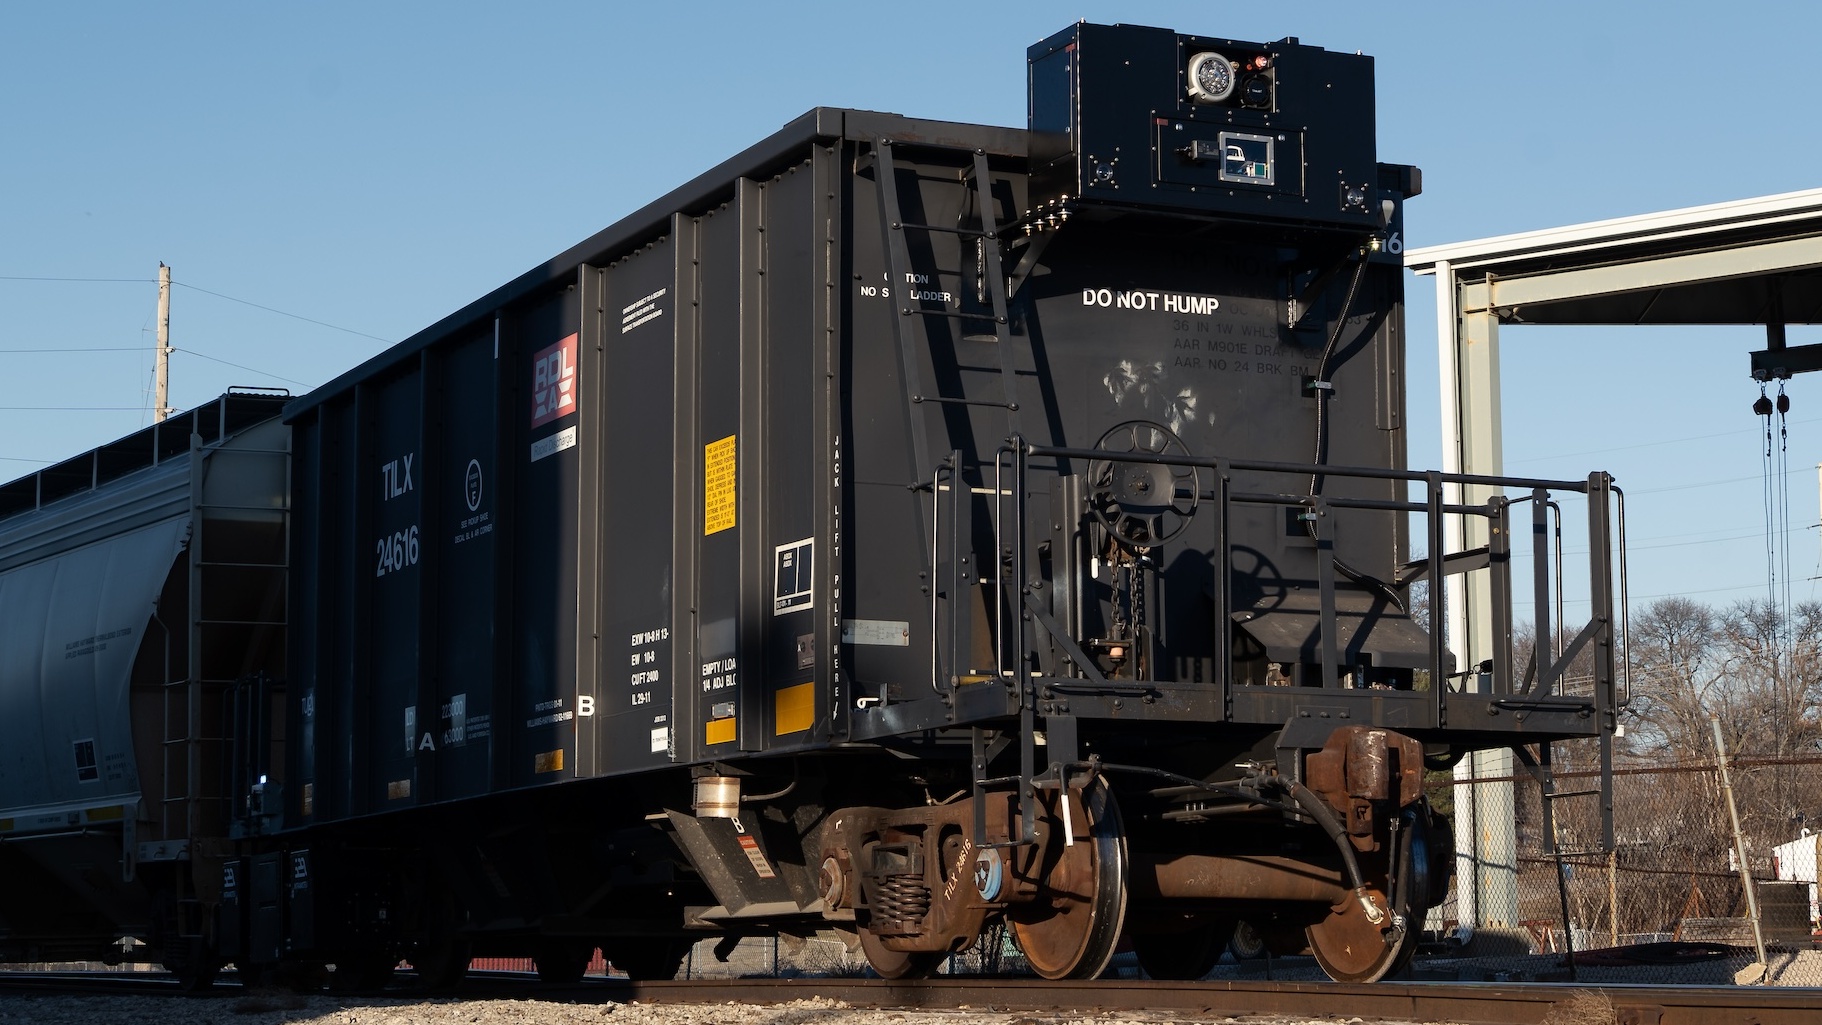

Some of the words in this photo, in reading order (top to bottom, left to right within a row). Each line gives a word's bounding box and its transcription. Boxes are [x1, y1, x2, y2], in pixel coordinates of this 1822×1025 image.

[860, 286, 876, 296] NO
[910, 290, 951, 302] LADDER
[1083, 288, 1112, 307] DO
[1116, 290, 1159, 310] NOT
[1164, 294, 1219, 315] HUMP
[1174, 320, 1188, 332] 36
[1197, 321, 1209, 332] IN
[1174, 338, 1200, 350] AAR
[1174, 356, 1200, 368] AAR
[1208, 358, 1227, 371] NO
[1234, 361, 1250, 372] 24
[1257, 362, 1282, 375] BRK
[382, 452, 414, 501] TILX
[472, 490, 476, 506] F
[376, 524, 418, 578] 24616
[632, 633, 643, 646] EXW
[644, 631, 655, 644] 10-8
[656, 629, 660, 641] H
[661, 628, 669, 640] 13-
[632, 653, 640, 666] EW
[644, 650, 655, 663] 10-8
[702, 660, 720, 676] EMPTY
[725, 658, 736, 672] LOA
[632, 673, 639, 686] CU
[639, 672, 646, 684] FT
[646, 670, 659, 683] 2400
[702, 678, 711, 692] 1/4
[712, 675, 724, 690] ADJ
[578, 695, 595, 716] B
[637, 691, 651, 704] 29-11
[406, 711, 414, 726] LD
[406, 736, 414, 751] LT
[419, 732, 435, 750] A
[944, 872, 958, 900] TILX
